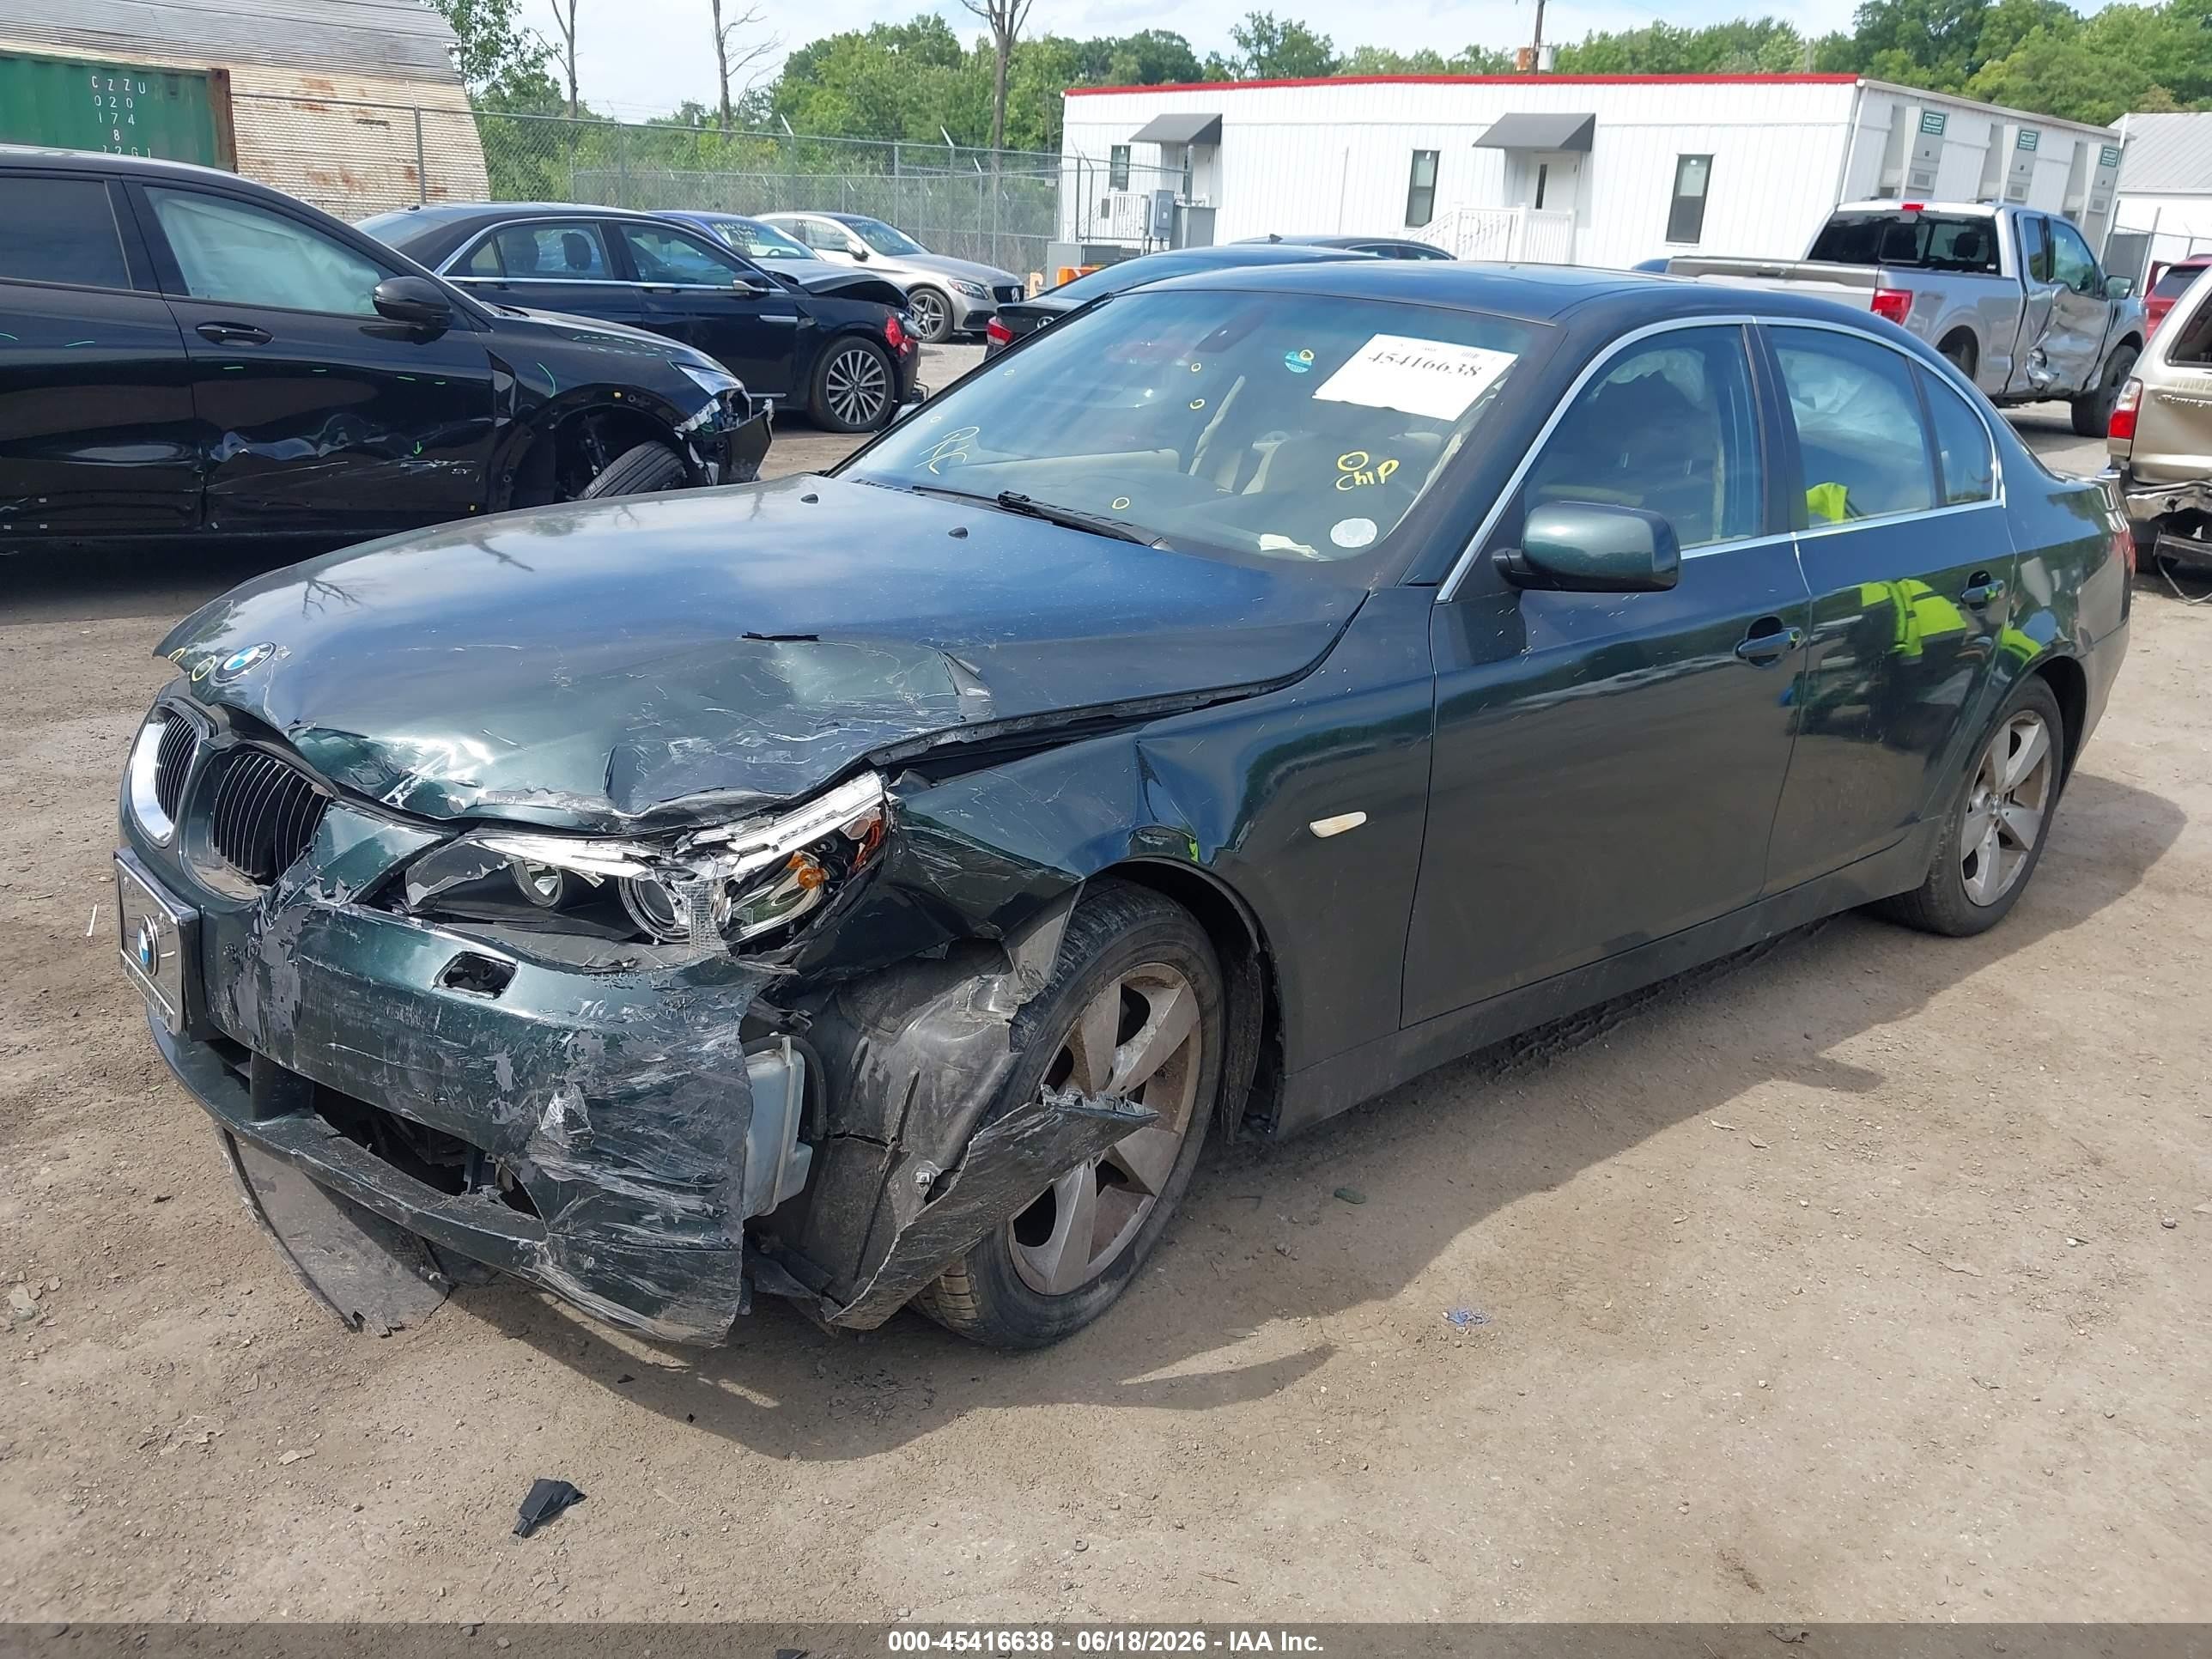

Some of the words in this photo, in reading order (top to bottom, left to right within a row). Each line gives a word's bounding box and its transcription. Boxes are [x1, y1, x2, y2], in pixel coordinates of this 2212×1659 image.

[93, 94, 134, 110] 020
[99, 111, 135, 125] 174
[113, 129, 120, 142] 8
